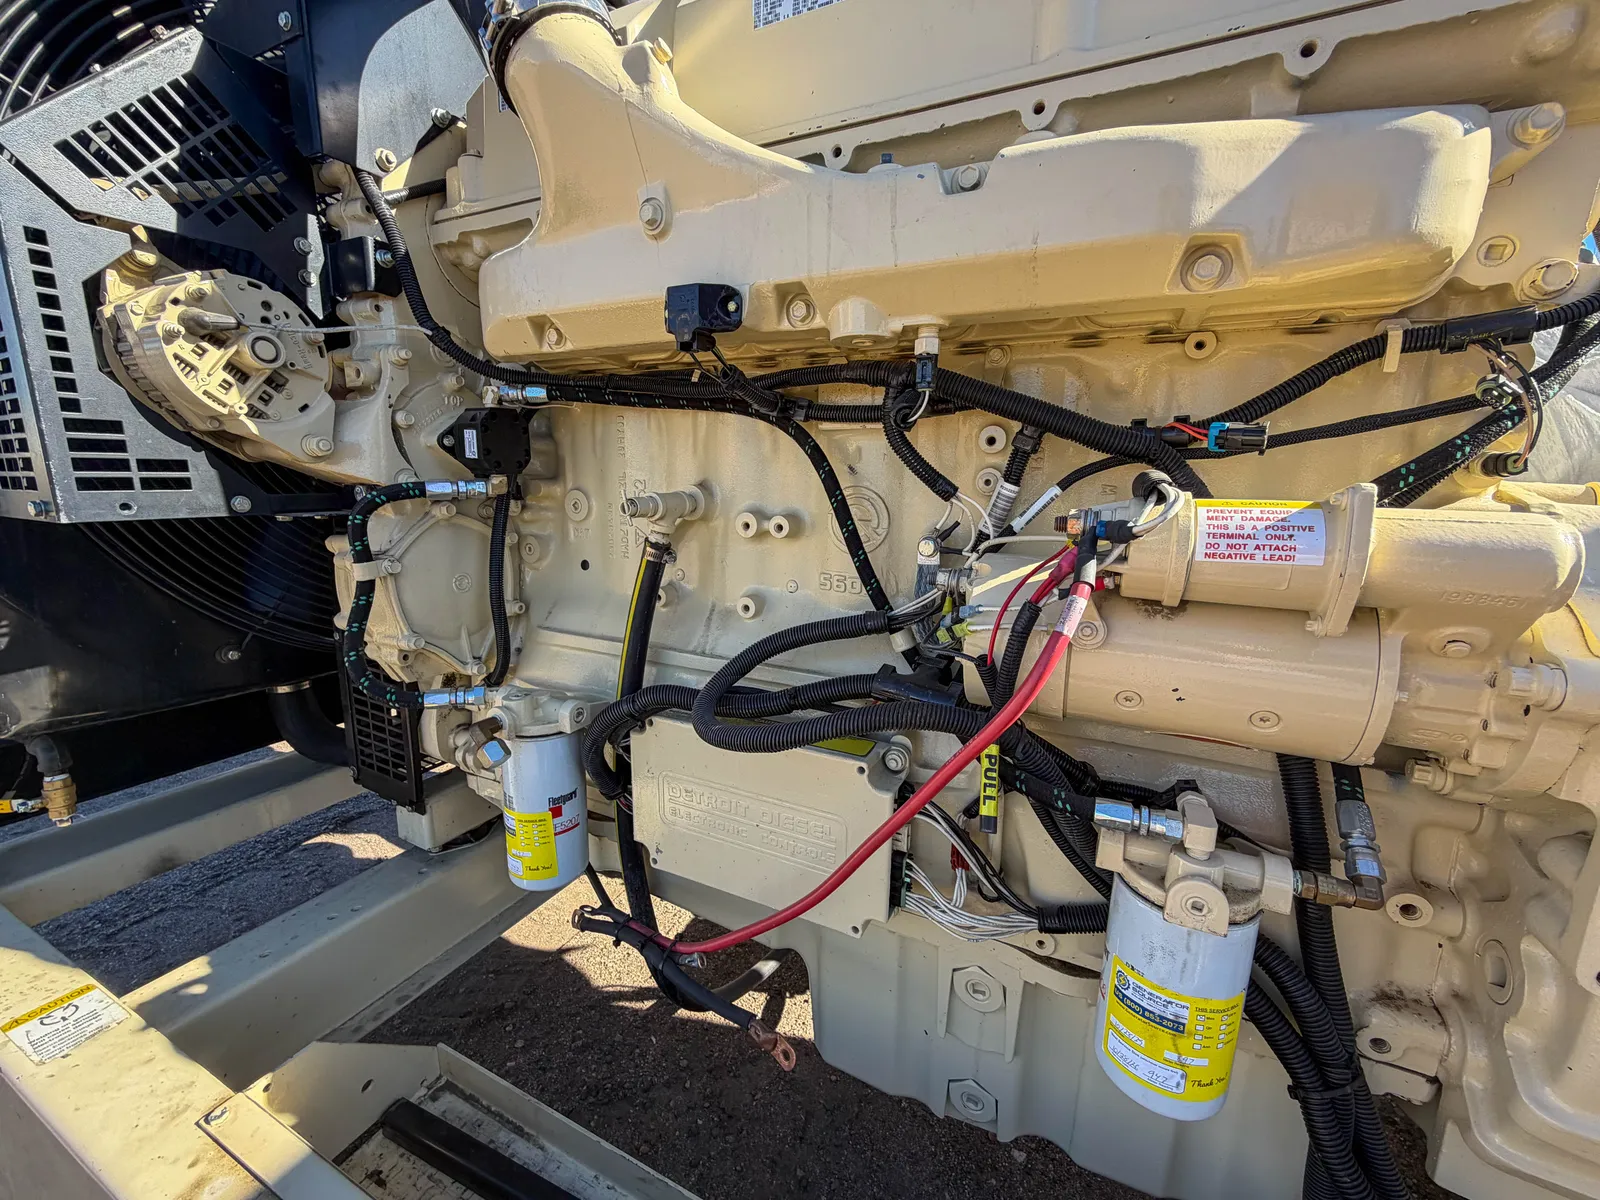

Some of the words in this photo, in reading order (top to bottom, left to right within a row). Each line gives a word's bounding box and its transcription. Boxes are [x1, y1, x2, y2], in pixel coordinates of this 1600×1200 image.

[1206, 523, 1230, 531] THIS
[1250, 524, 1259, 532] A
[1264, 525, 1316, 533] POSITIVE
[1206, 532, 1260, 540] TERMINAL
[1204, 552, 1257, 561] NEGATIVE
[1262, 553, 1296, 562] LEAD!
[1205, 542, 1220, 550] DO
[1253, 544, 1297, 552] ATTACH
[982, 753, 998, 806] PULL
[668, 783, 750, 817] DETROIT
[759, 807, 837, 843] DIESEL
[668, 807, 748, 838] ELECTRONIC
[760, 831, 836, 864] CONTROLS
[27, 985, 91, 1017] CAUTION
[1131, 986, 1169, 1010] SOURCE
[1132, 981, 1190, 1011] GENERATOR
[1123, 998, 1143, 1016] (800)
[1144, 1010, 1184, 1031] 853-2073
[1191, 1078, 1214, 1088] Thank
